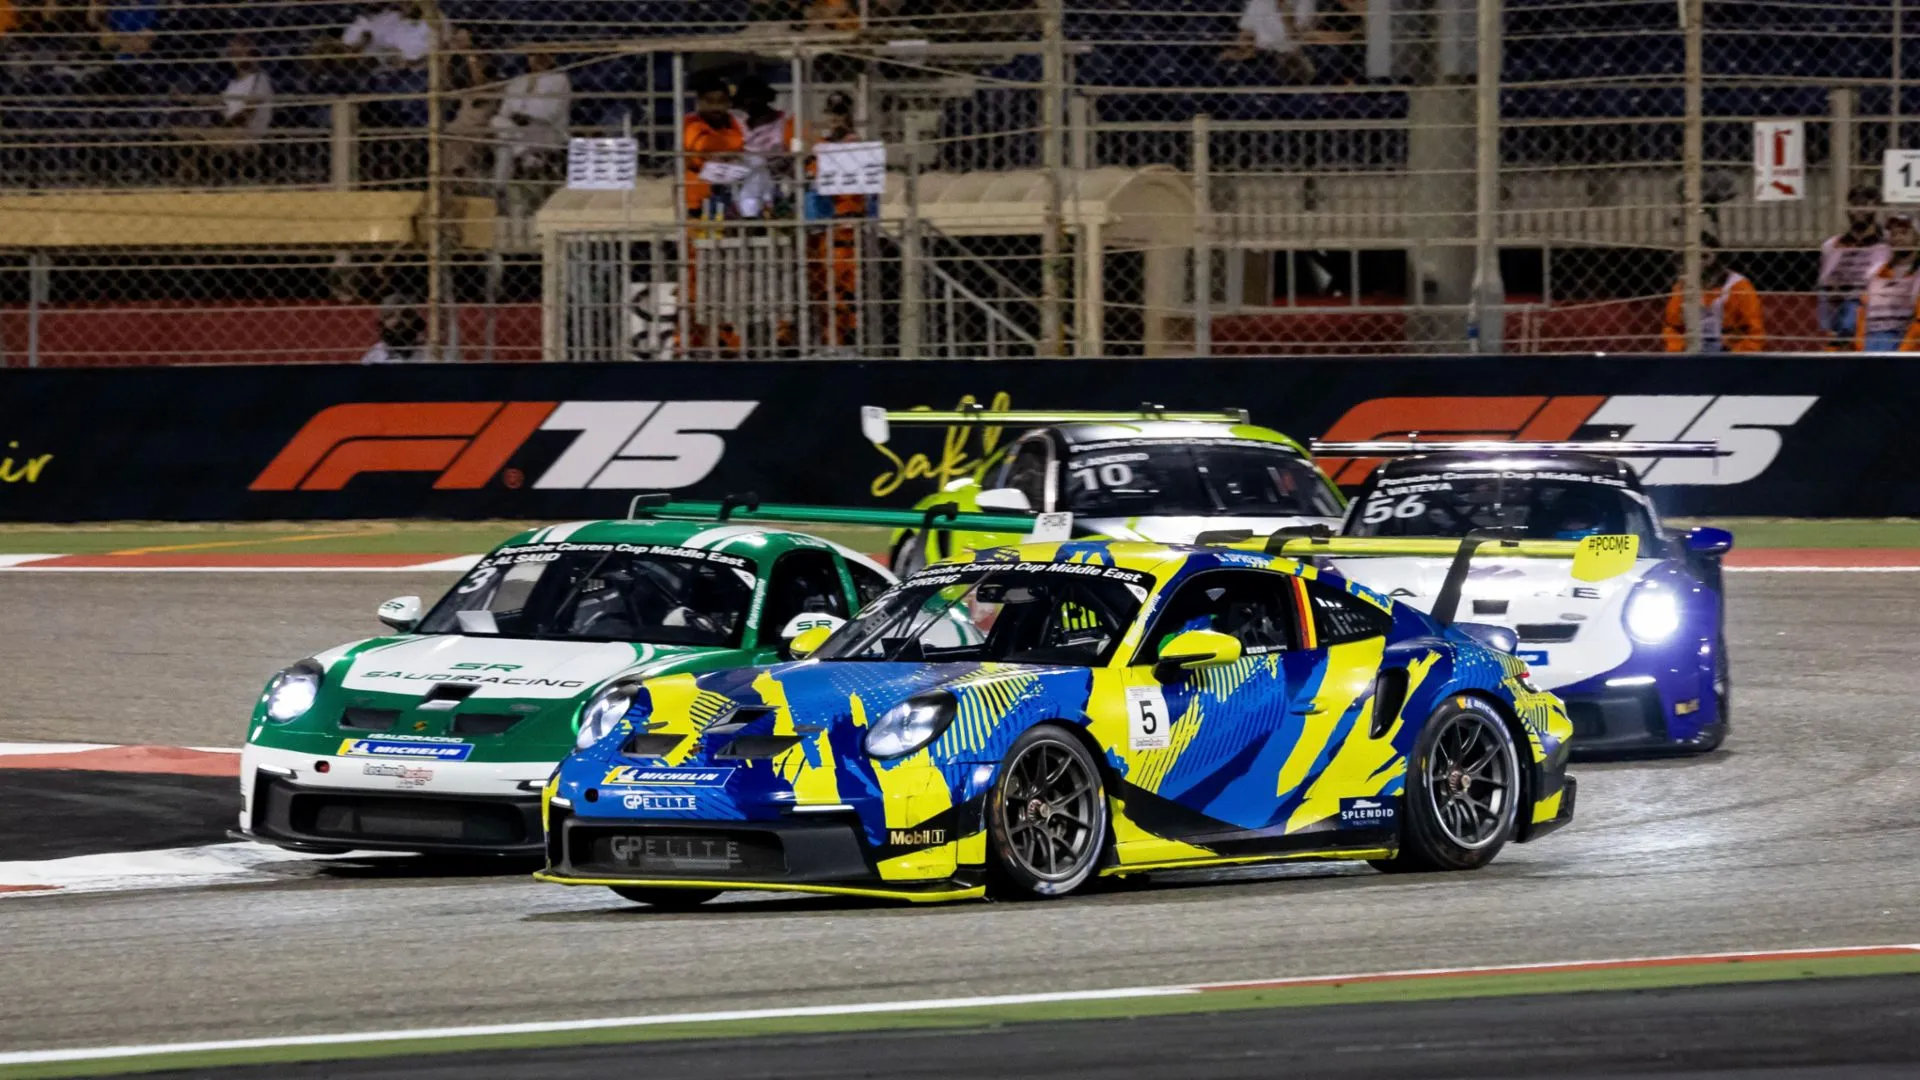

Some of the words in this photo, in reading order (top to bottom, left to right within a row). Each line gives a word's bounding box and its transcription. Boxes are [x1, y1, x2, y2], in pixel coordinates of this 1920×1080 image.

[531, 401, 760, 489] 75
[0, 440, 54, 483] ir
[1072, 463, 1133, 490] 10
[1363, 494, 1426, 524] 56
[556, 541, 613, 552] Carrera
[615, 543, 649, 555] Cup
[650, 545, 706, 560] Middle
[708, 552, 747, 567] East
[457, 567, 498, 594] 3
[961, 562, 1014, 573] Carrera
[1014, 561, 1045, 573] Cup
[1047, 563, 1102, 577] Middle
[1102, 568, 1143, 583] East
[360, 671, 585, 688] SAUDIRACING
[449, 662, 524, 673] SR
[1139, 700, 1157, 735] 5
[373, 746, 462, 755] MICHELIN
[637, 772, 719, 781] MICHELIN
[1341, 808, 1394, 820] SPLENDID
[890, 830, 930, 845] Mobil
